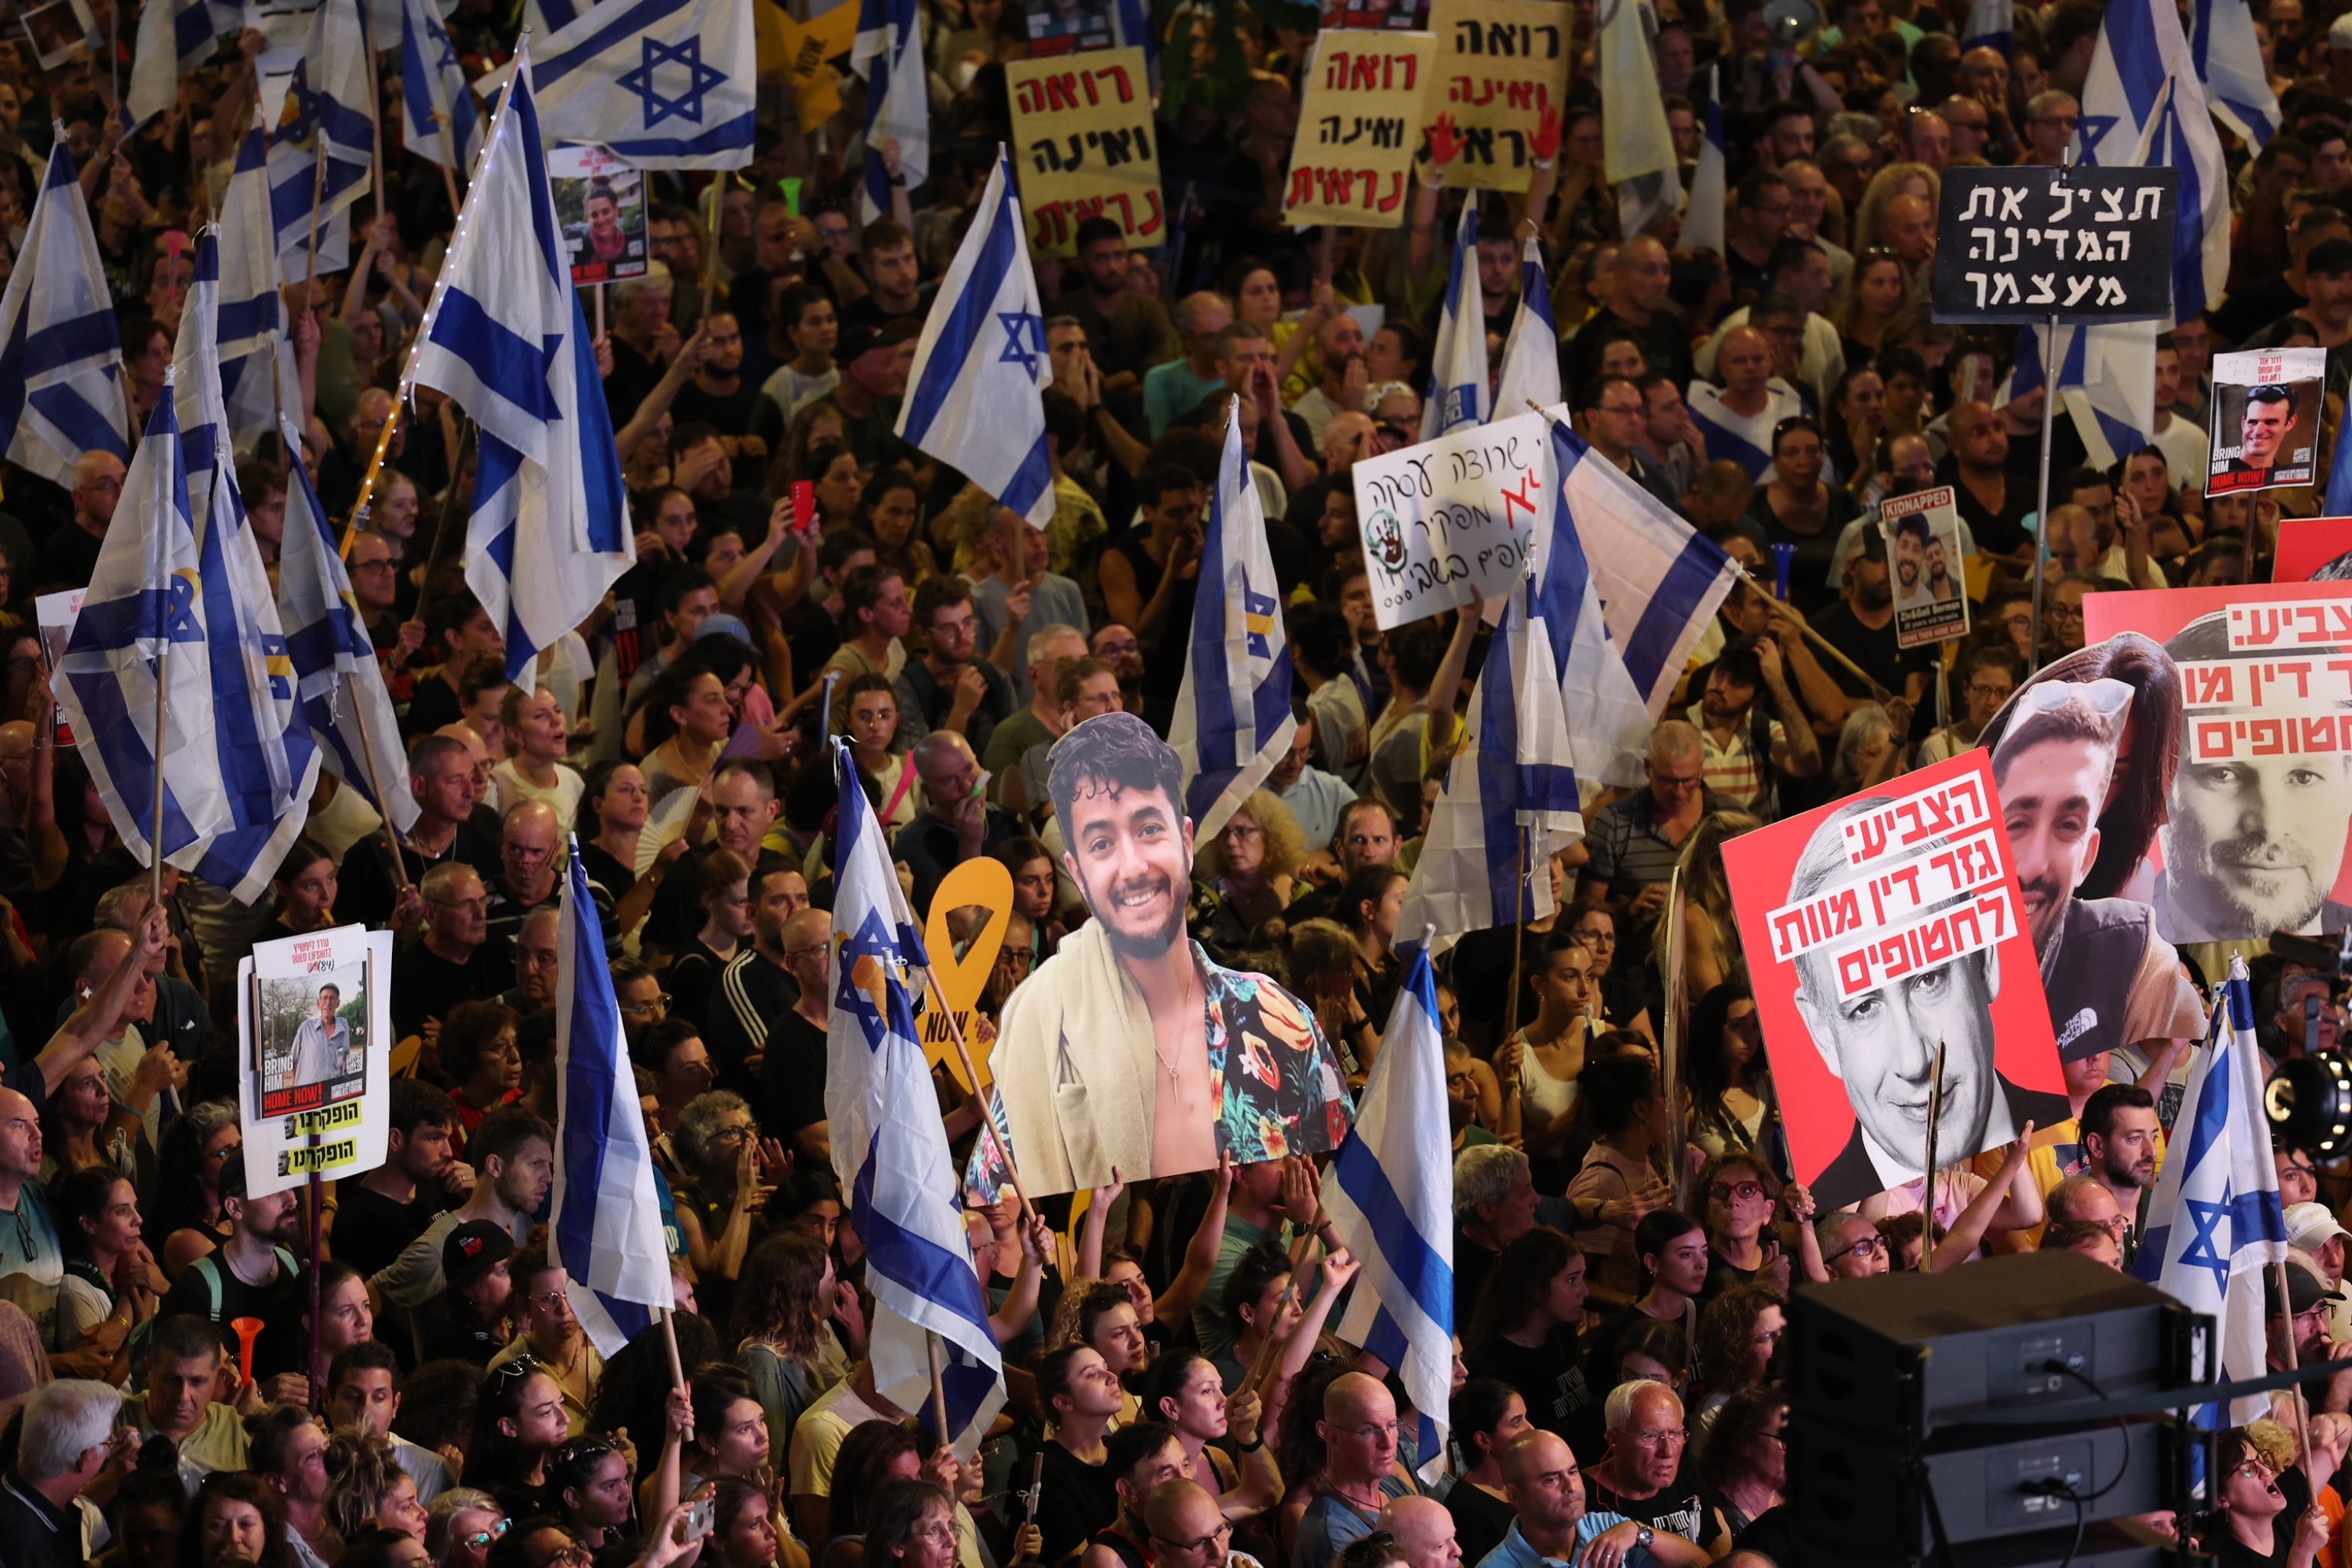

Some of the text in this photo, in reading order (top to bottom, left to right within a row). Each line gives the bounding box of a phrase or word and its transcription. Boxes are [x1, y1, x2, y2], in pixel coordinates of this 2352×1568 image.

[1455, 21, 1560, 59] רואה
[1016, 65, 1133, 114] רואה
[1328, 51, 1416, 91] רואה
[1449, 76, 1547, 112] ואינה
[1031, 126, 1151, 174] ואינה
[1320, 116, 1404, 149] ואינה
[1285, 166, 1403, 213] נראית
[1958, 181, 2164, 223] תציל את
[1034, 190, 1162, 249] נראית
[1968, 227, 2131, 263] המדינה
[1965, 272, 2127, 310] מעצמך
[2211, 459, 2229, 475] HIM
[2213, 446, 2240, 461] BRING
[1367, 454, 1433, 513] עסקה
[2210, 469, 2266, 489] HOME NOW!
[1415, 498, 1492, 545] מפקיר
[1885, 491, 1949, 517] KIDNAPPED
[1478, 530, 1533, 576] ופים
[2233, 606, 2352, 645] צביע:
[2185, 666, 2234, 704] מו
[2249, 662, 2311, 707] דין
[1845, 780, 1982, 864] הצביע:
[1774, 839, 1998, 956] גזר דין מוות
[292, 948, 332, 964] ODED LIFSHITZ
[1838, 895, 2004, 995] לחטופים
[318, 959, 335, 972] (84)
[924, 1011, 969, 1043] NOW.
[264, 1055, 294, 1076] BRING
[264, 1073, 283, 1093] HIM
[264, 1090, 292, 1109] HOME
[294, 1083, 323, 1105] NOW!
[299, 1102, 358, 1130] הופקרנו
[293, 1140, 354, 1169] הופקרנו
